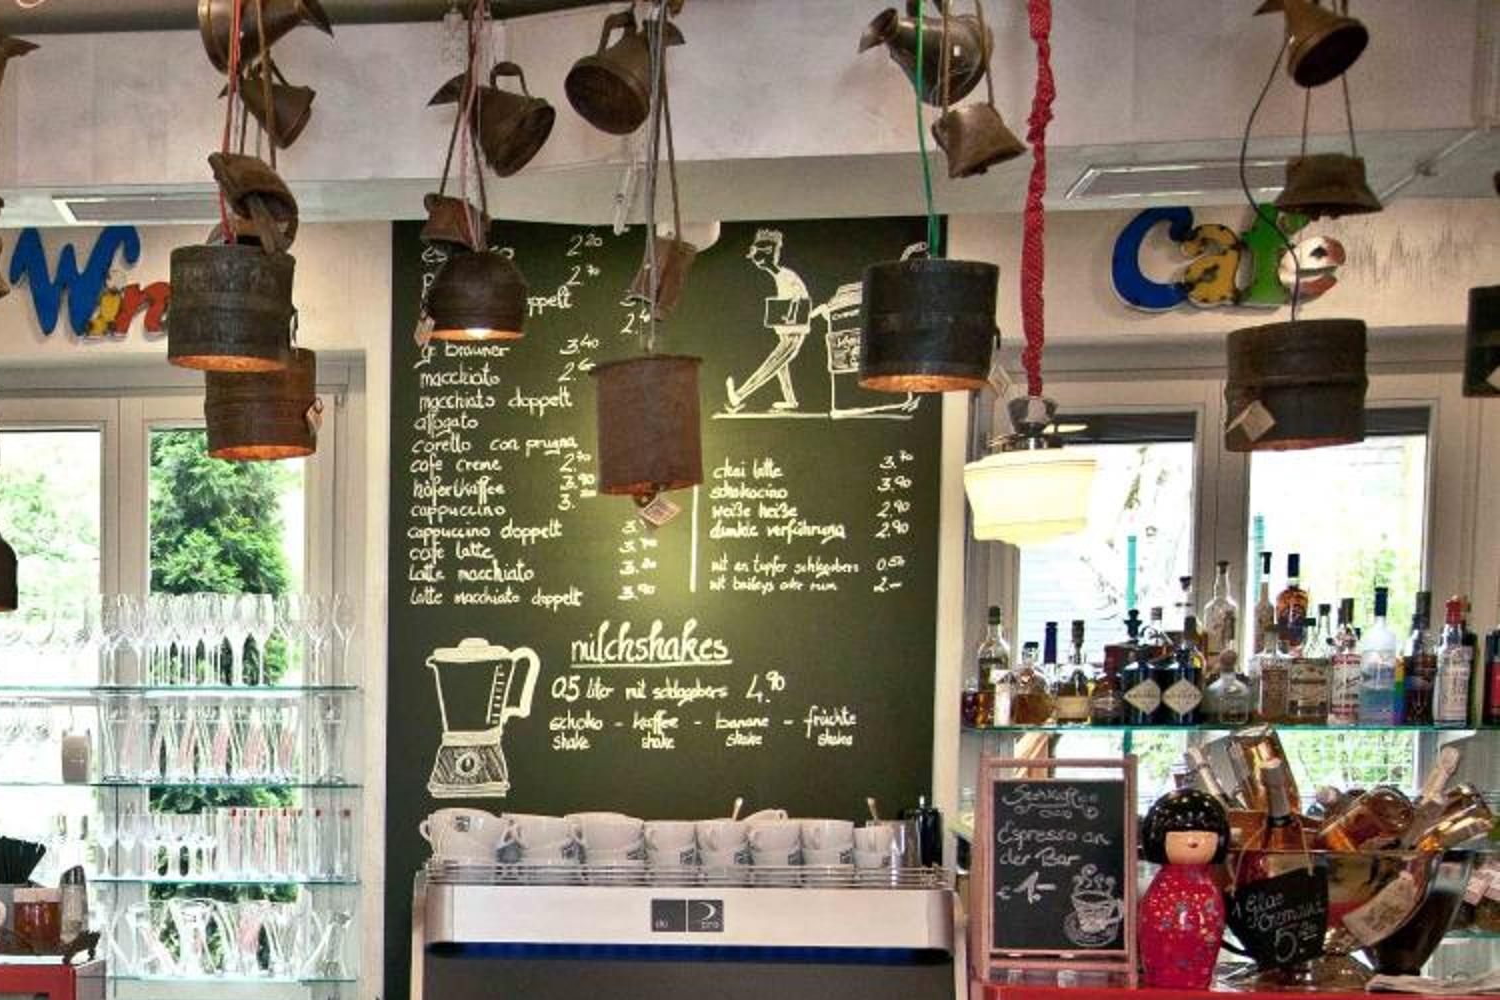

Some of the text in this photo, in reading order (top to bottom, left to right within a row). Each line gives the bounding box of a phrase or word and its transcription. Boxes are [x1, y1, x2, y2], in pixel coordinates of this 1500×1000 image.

[419, 362, 501, 389] macchiato
[419, 386, 573, 417] macchiato doppelt
[413, 410, 479, 438] affogato
[489, 438, 521, 451] con
[499, 518, 563, 547] doppelt
[455, 536, 494, 560] latte
[457, 558, 535, 582] macchiato
[453, 585, 520, 606] macchiato
[530, 585, 584, 613] doppelt
[570, 617, 729, 662] milchshakes
[549, 710, 604, 730] schoko
[631, 709, 680, 733] kaffee
[715, 710, 770, 730] banane
[997, 820, 1077, 851] Espresso
[1034, 846, 1082, 867] Bar
